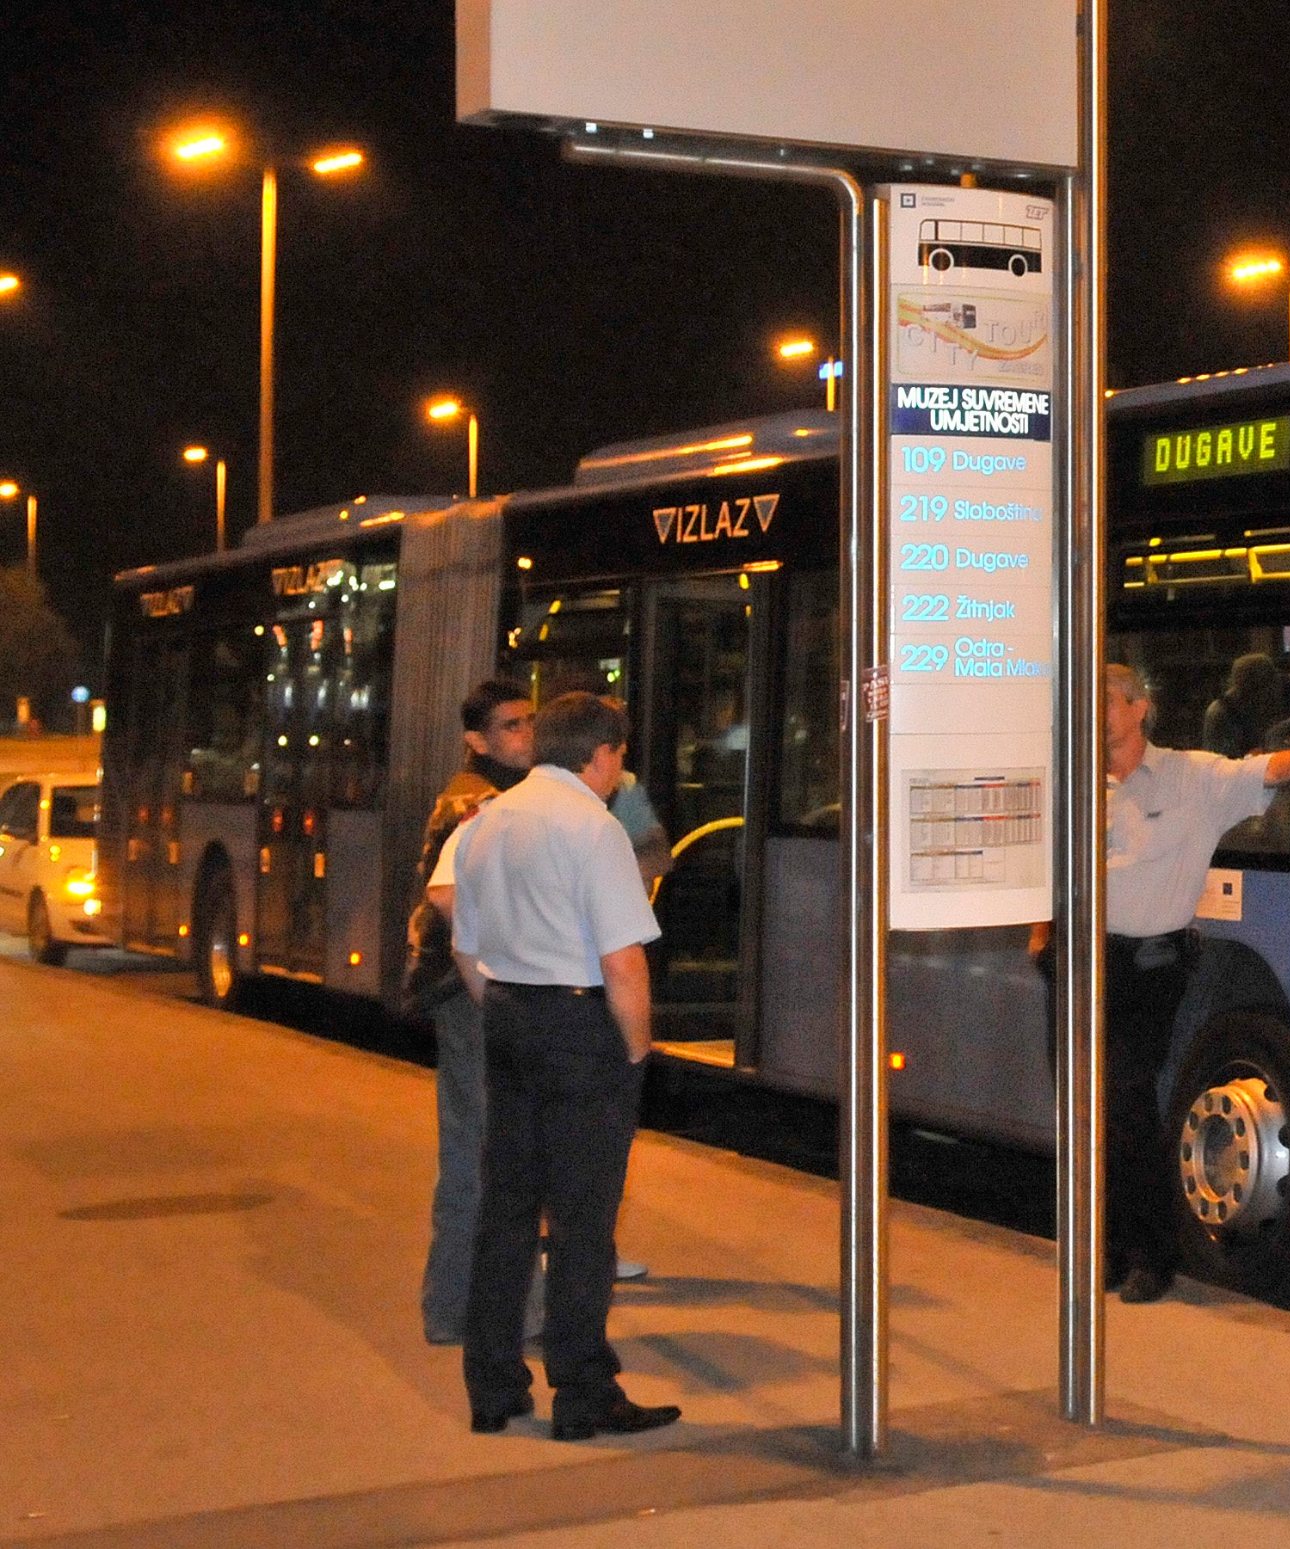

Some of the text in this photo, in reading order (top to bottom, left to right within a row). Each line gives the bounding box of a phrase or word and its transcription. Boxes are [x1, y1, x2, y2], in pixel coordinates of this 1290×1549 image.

[898, 386, 1049, 415] MUZEJ SUVREMENE
[930, 409, 1029, 434] UMJETNOSTI
[900, 446, 1027, 475] 109 Dugave
[1155, 422, 1277, 473] DUGAVE
[676, 498, 751, 543] IZLAZ
[900, 495, 948, 522] 219
[900, 544, 1029, 573] 220 Dugave
[901, 594, 1015, 622] 222 Žitnjak
[900, 644, 949, 672] 229
[954, 637, 1005, 657] Odra
[954, 657, 1003, 677] Mala
